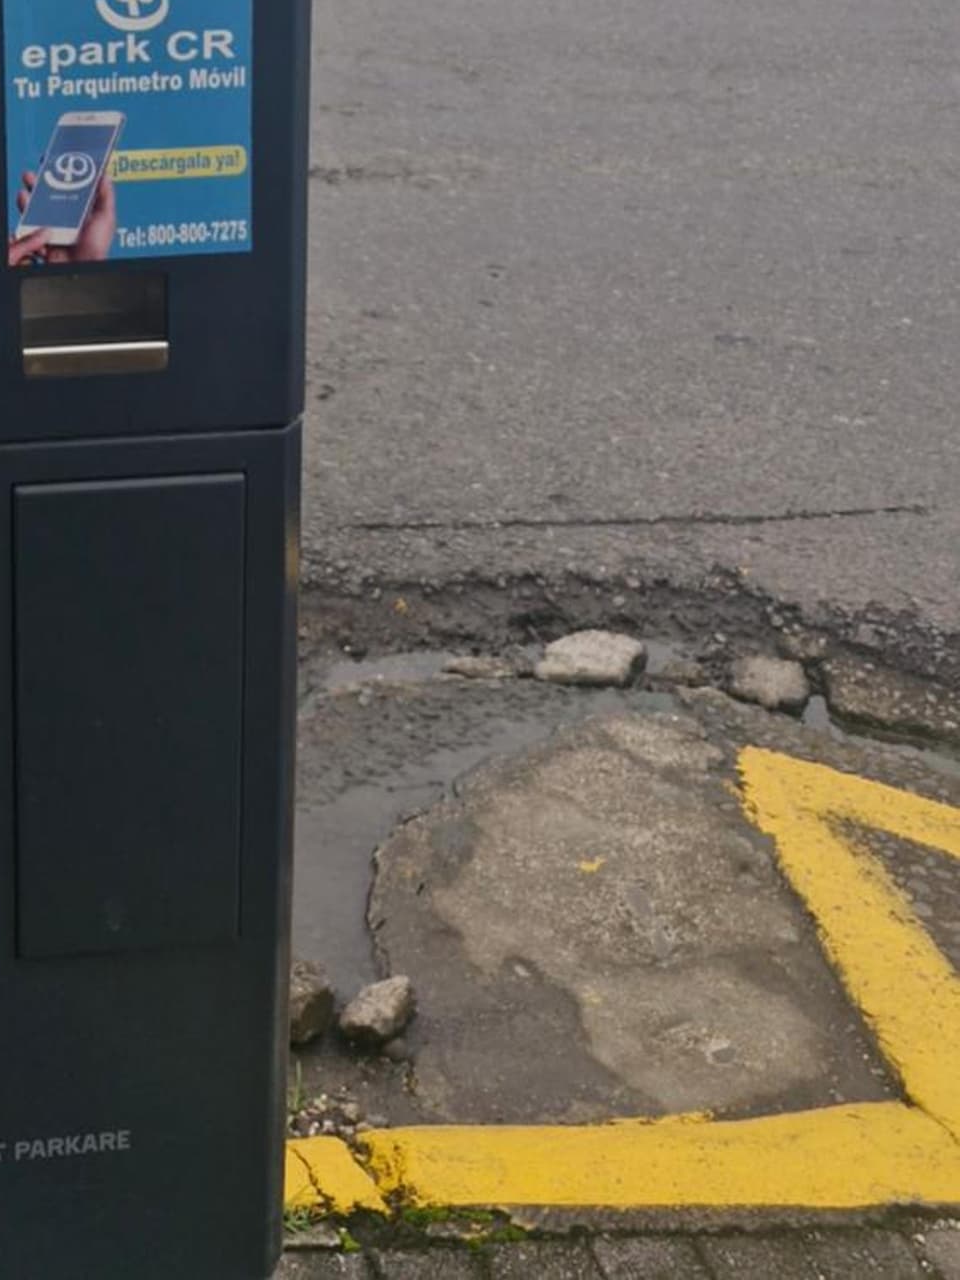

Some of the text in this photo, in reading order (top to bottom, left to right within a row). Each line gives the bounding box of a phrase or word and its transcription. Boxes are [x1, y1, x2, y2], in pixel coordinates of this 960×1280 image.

[21, 29, 236, 74] epark CR
[14, 77, 40, 99] Tu
[189, 66, 246, 90] Móvil
[215, 149, 240, 172] ya!
[14, 1130, 131, 1161] PARKARE
